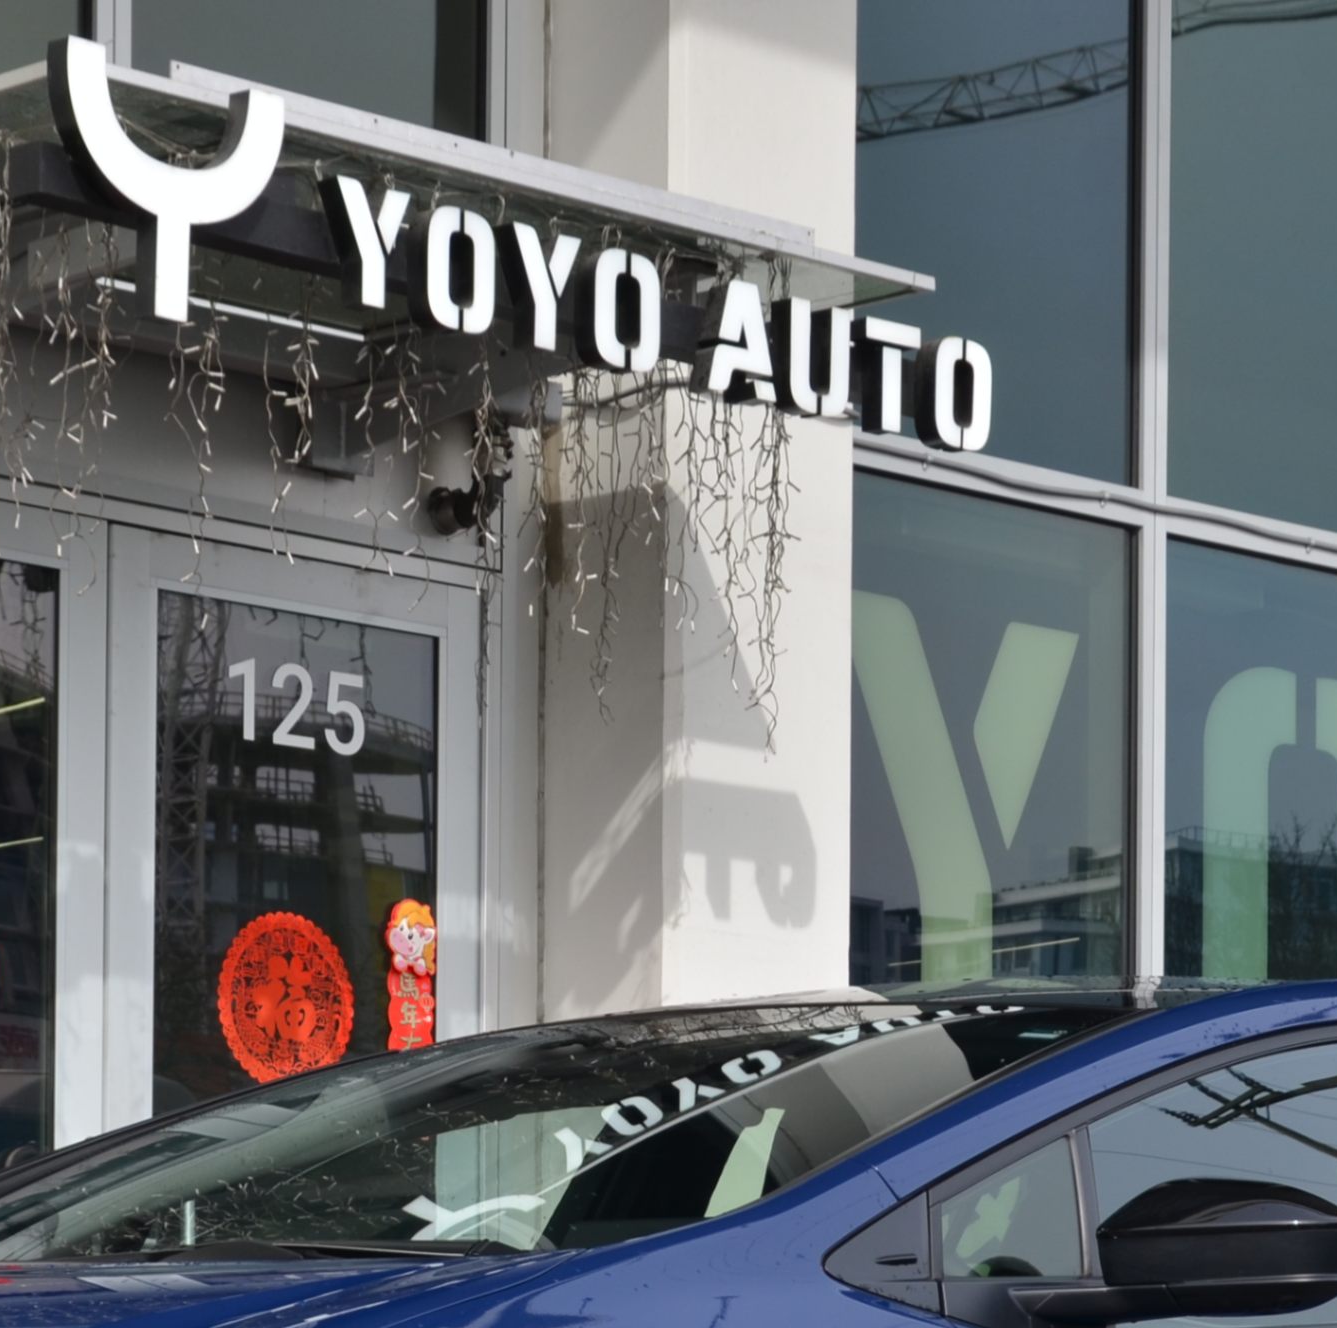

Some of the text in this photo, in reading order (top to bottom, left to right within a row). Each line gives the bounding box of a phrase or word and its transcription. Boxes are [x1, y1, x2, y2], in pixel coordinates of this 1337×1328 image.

[321, 175, 994, 452] YOYO AUTO
[228, 658, 365, 756] 125
